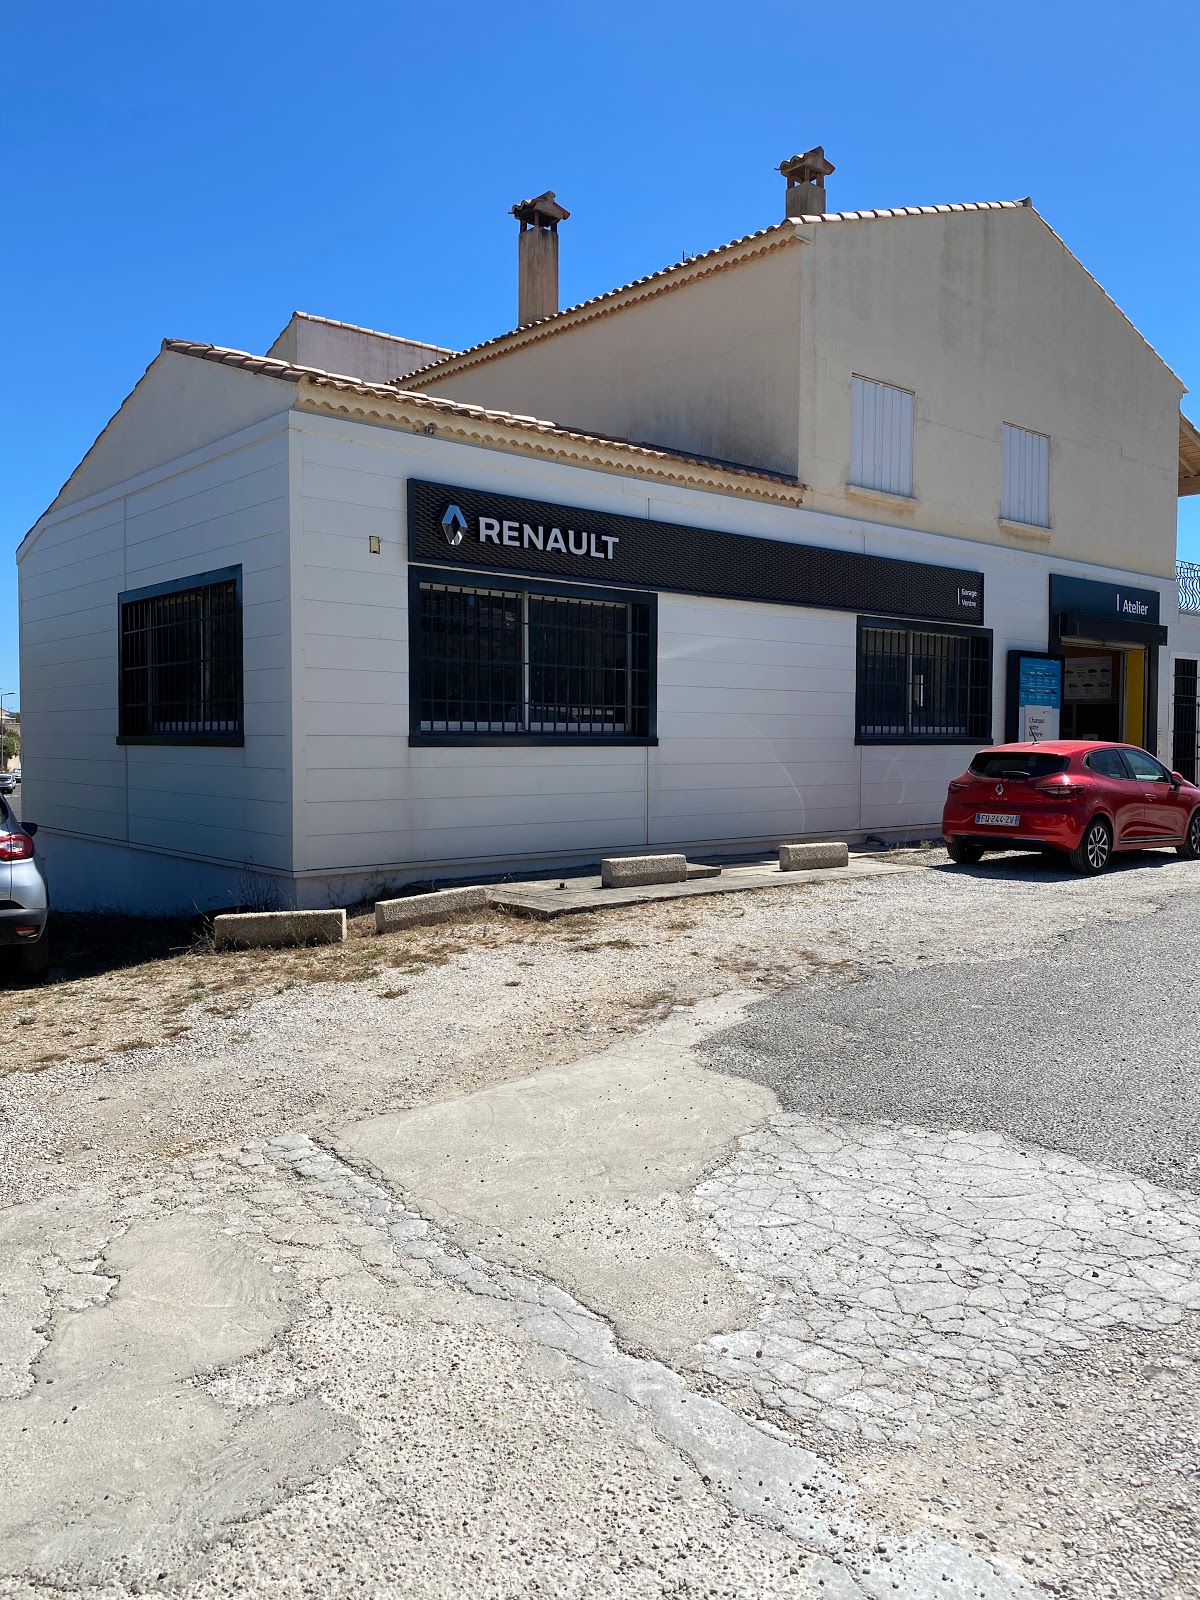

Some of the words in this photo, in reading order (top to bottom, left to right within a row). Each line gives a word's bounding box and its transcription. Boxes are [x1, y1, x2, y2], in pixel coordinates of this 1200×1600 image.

[478, 516, 619, 560] RENAULT
[961, 588, 977, 598] Garage
[1122, 599, 1149, 616] Atelier
